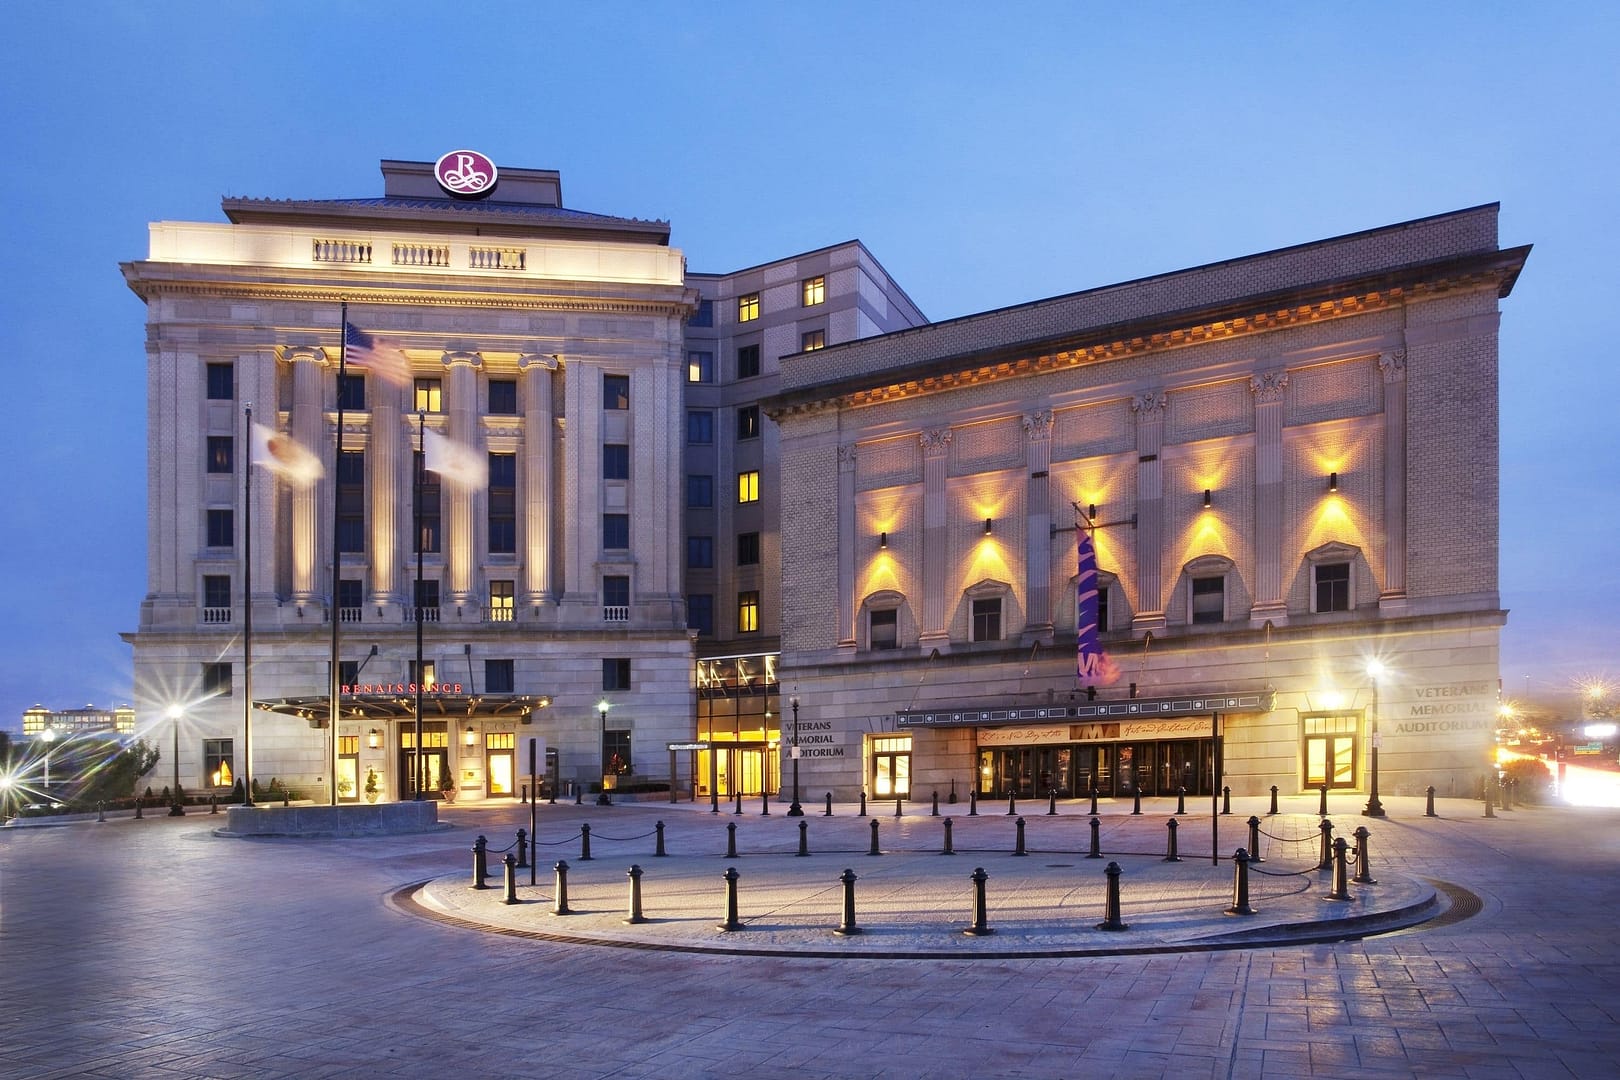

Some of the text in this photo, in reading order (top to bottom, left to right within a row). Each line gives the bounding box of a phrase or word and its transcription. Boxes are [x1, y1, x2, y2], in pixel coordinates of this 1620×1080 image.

[341, 683, 462, 695] RENAISSANCE
[1416, 685, 1489, 697] VETERANS
[1411, 702, 1487, 716] MEMORIAL
[786, 722, 831, 731] VTERANS
[1396, 719, 1489, 733] AUDITORIUM
[786, 735, 834, 744] MMORIAL
[786, 747, 844, 758] ADITORIUM
